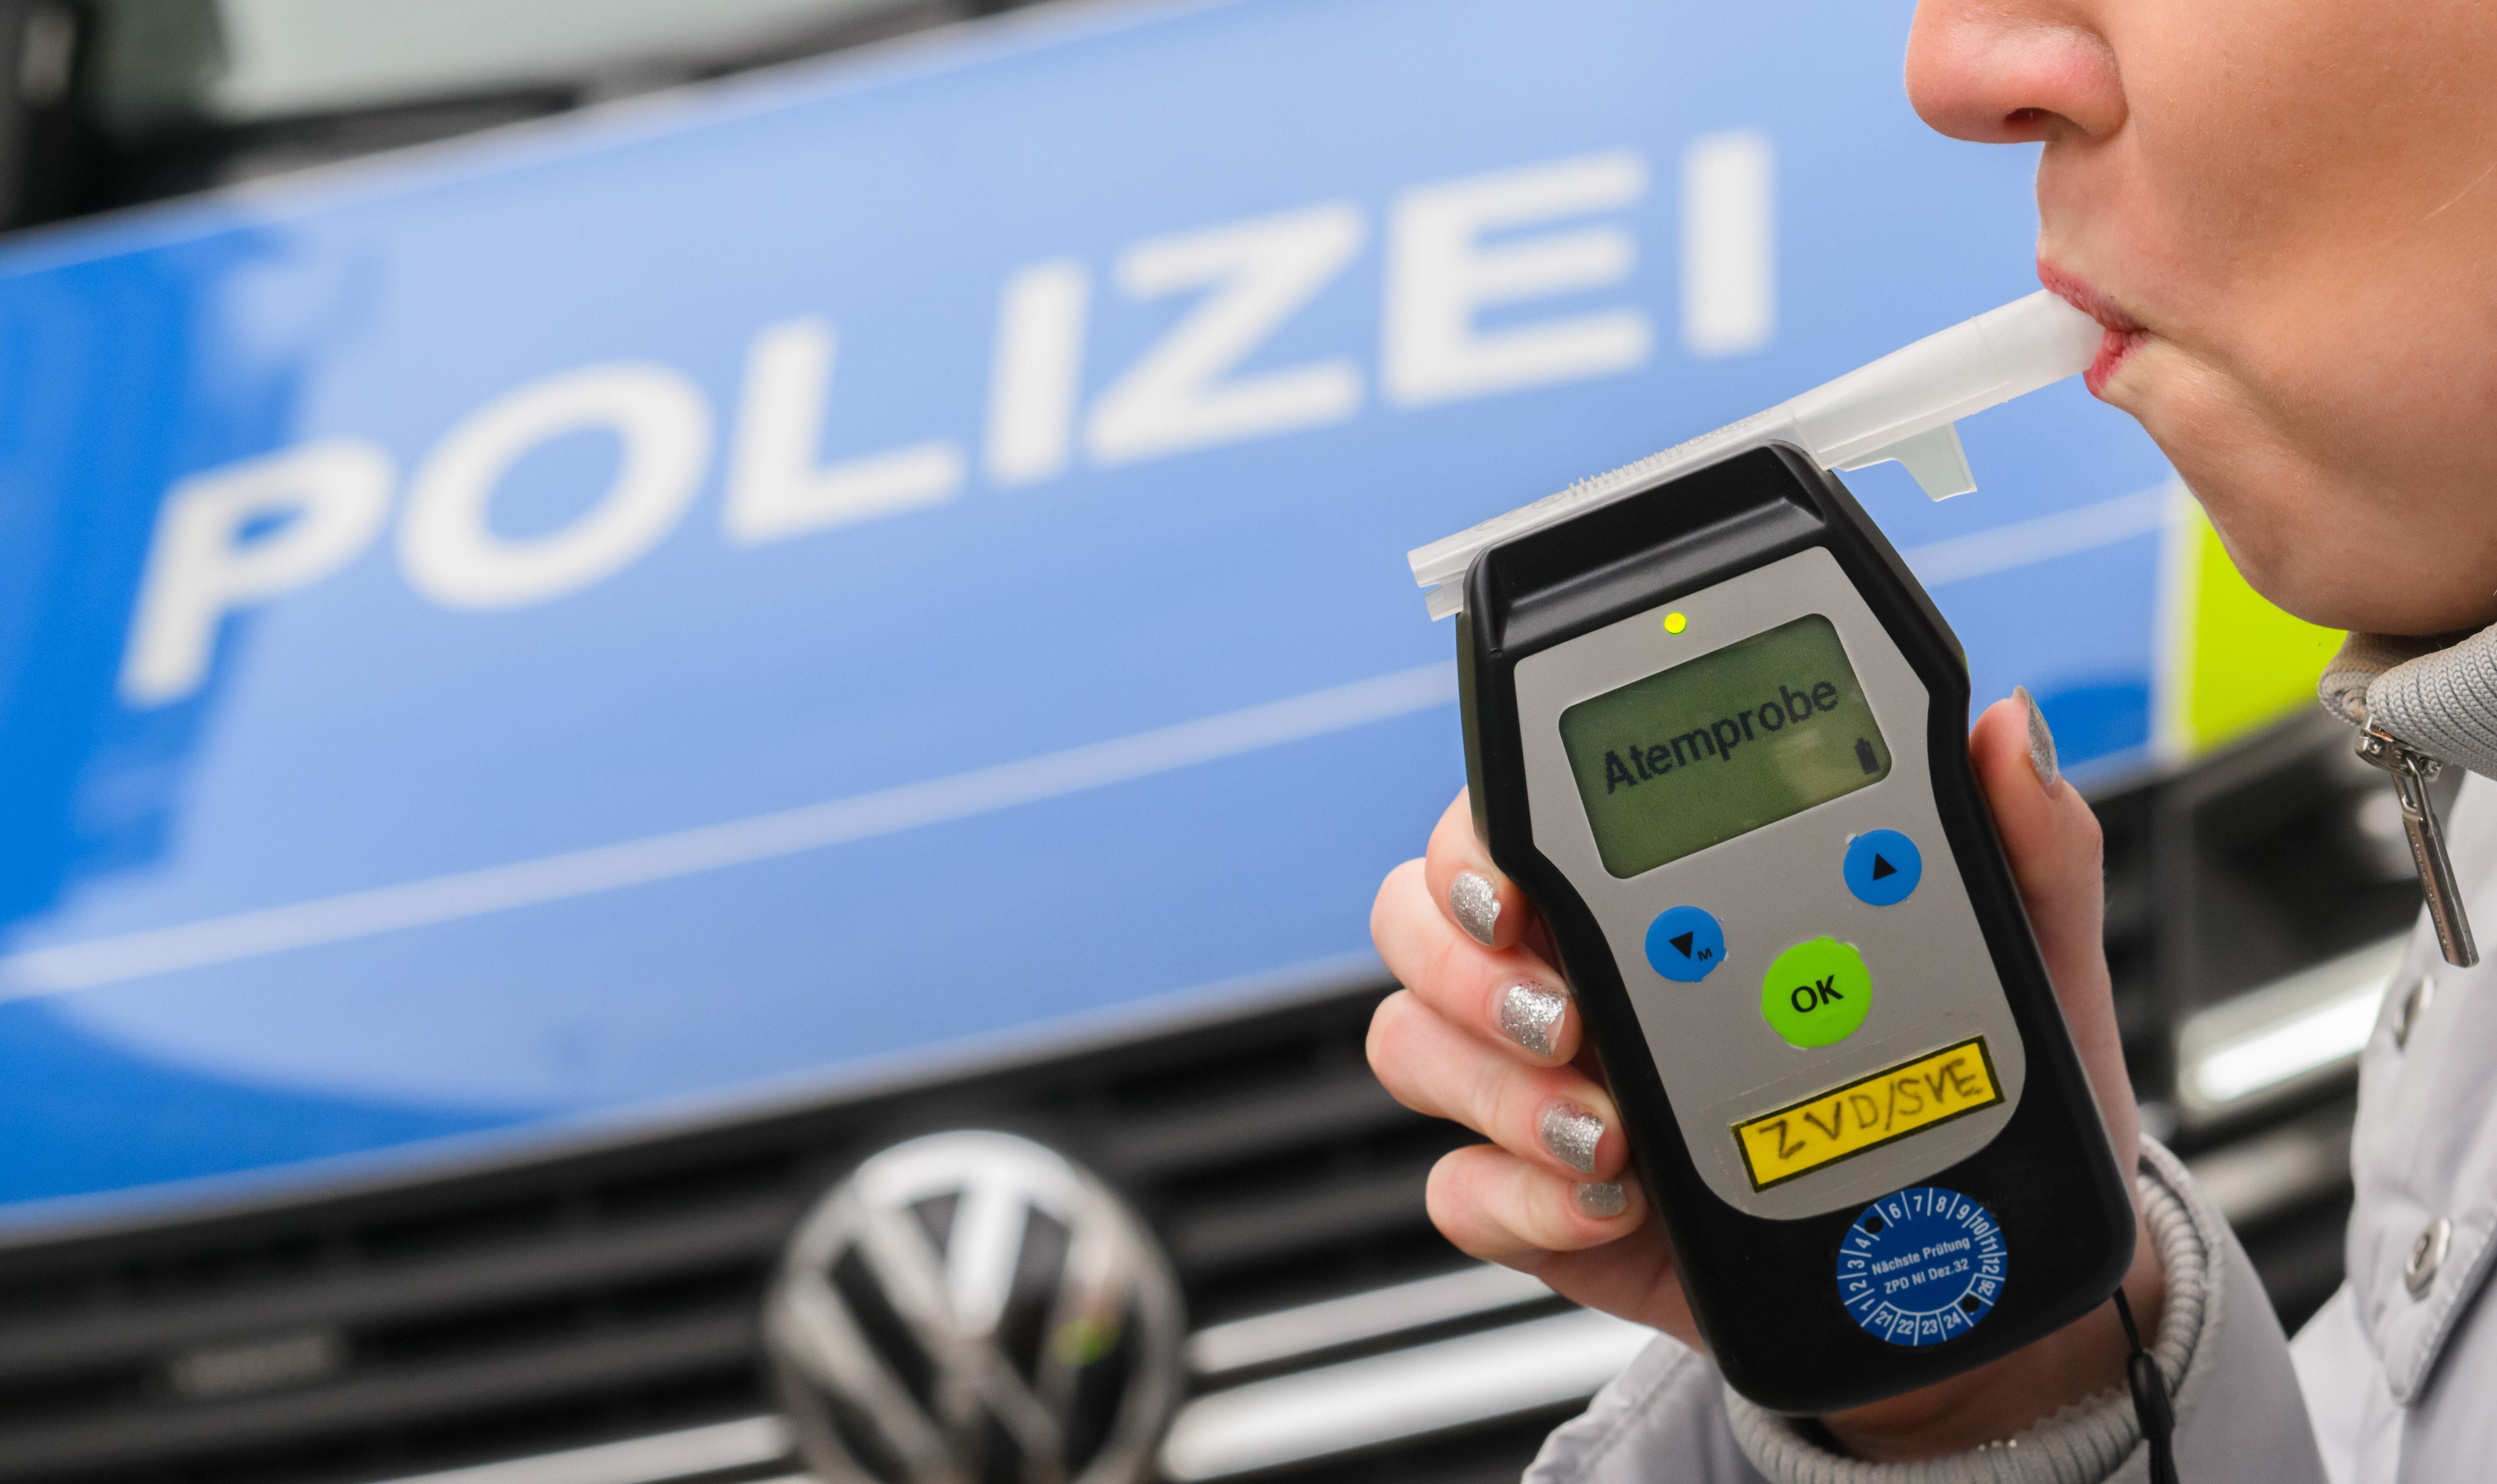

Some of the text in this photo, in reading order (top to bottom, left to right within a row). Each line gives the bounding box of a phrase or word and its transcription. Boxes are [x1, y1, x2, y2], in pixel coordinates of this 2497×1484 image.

[114, 131, 1775, 707] POLIZEI
[1604, 680, 1839, 795] Atemprobe
[1697, 947, 1713, 962] M
[1791, 974, 1844, 1013] OK
[1888, 1203, 1901, 1219] 6
[1913, 1195, 1922, 1212] 7
[1936, 1196, 1947, 1213] 8
[1956, 1204, 1971, 1220] 9
[1969, 1216, 1990, 1235] 10
[1855, 1237, 1872, 1249] 4
[1980, 1236, 1998, 1252] 11
[1847, 1259, 1865, 1269] 3
[1872, 1237, 1971, 1276] Nächste Prüfung
[1982, 1257, 2000, 1274] 12
[1849, 1280, 1867, 1291] 2
[1884, 1276, 1909, 1294] ZPD
[1911, 1271, 1926, 1285] NI
[1860, 1298, 1874, 1311] 1
[1874, 1311, 1893, 1327] 21
[1896, 1319, 1914, 1335] 22
[1922, 1319, 1938, 1335] 23
[1943, 1312, 1962, 1329] 24
